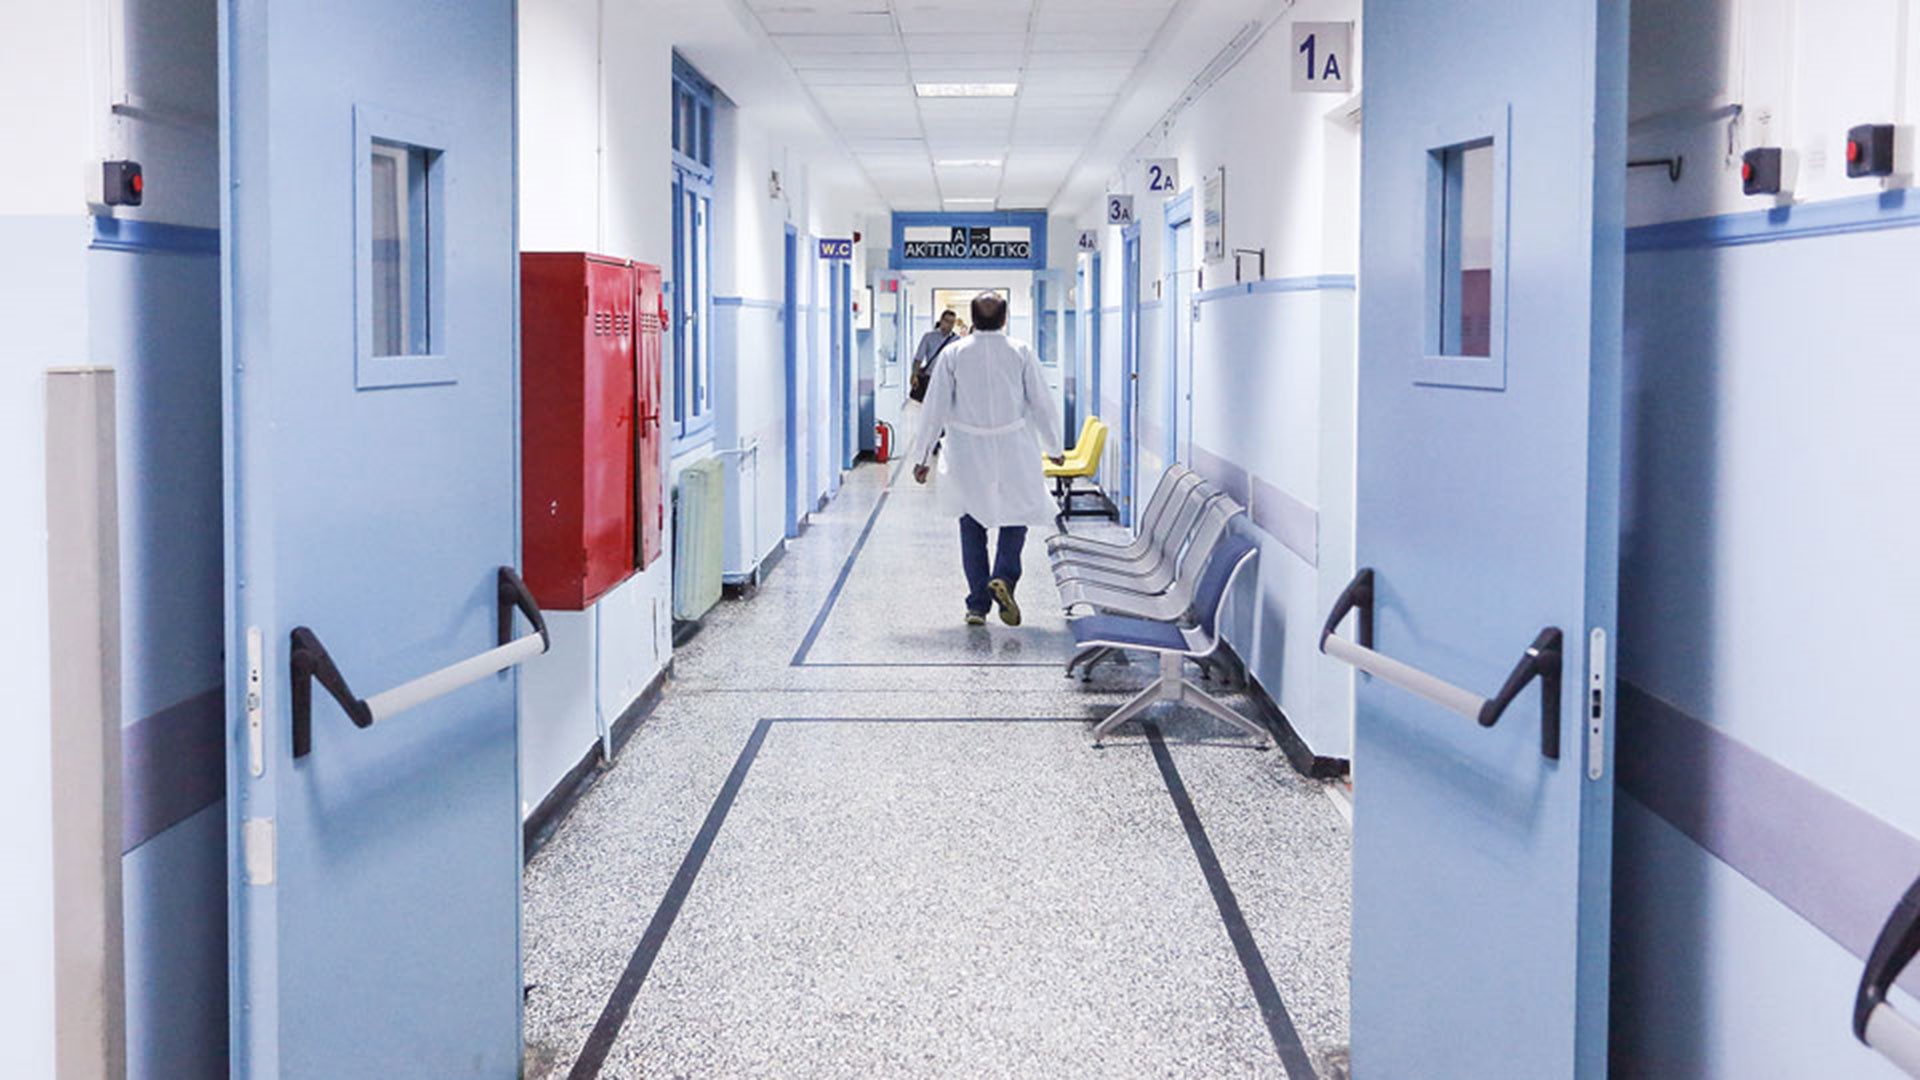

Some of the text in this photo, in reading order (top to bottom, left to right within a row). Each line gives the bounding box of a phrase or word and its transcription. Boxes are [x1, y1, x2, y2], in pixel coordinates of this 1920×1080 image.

[1299, 33, 1341, 80] 1A
[1149, 165, 1175, 190] 2A
[1111, 199, 1131, 220] 3A
[821, 243, 850, 256] W.C
